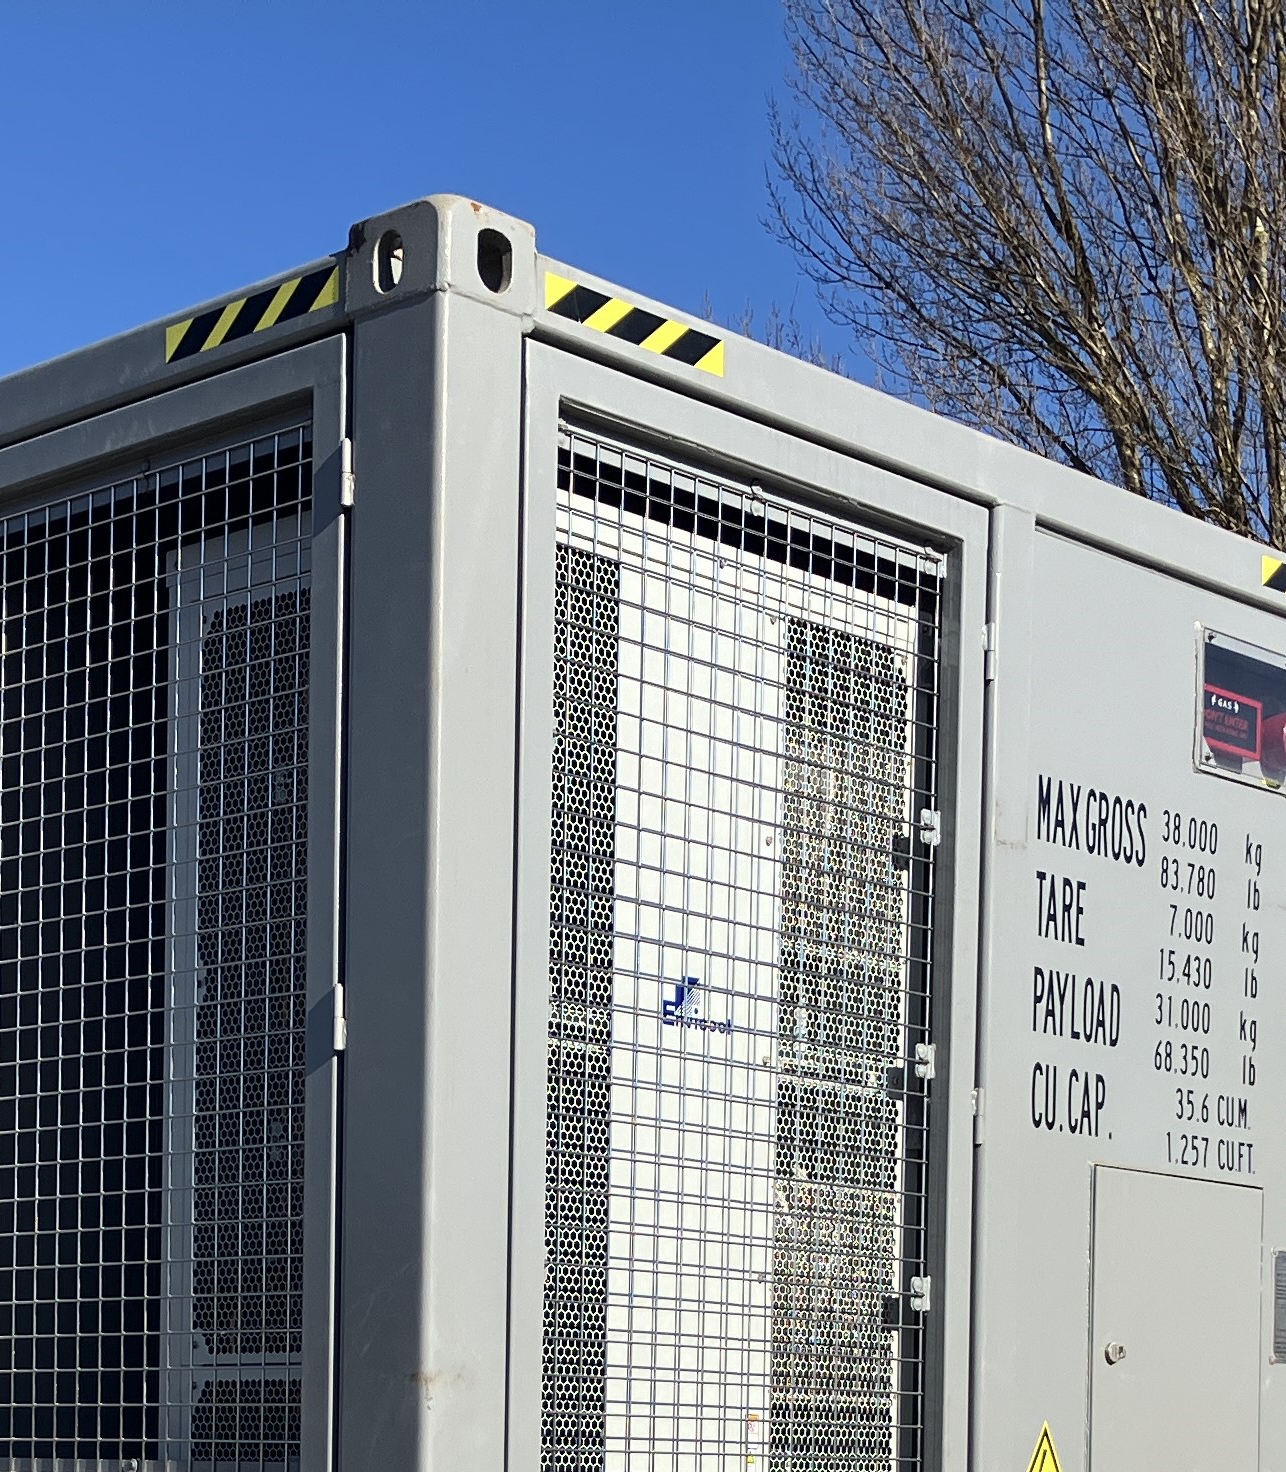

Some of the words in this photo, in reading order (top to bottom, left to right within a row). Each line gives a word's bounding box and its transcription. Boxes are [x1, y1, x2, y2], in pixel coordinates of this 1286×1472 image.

[1217, 698, 1233, 710] GAS
[1037, 773, 1081, 851] MAX
[1085, 788, 1147, 867] GROSS
[1245, 833, 1262, 877] kg
[1247, 879, 1260, 911] lb
[1036, 870, 1086, 946] TARE
[1242, 922, 1259, 964] kg
[1245, 967, 1258, 999] lb
[1032, 966, 1121, 1047] PAYLOAD
[1239, 1010, 1257, 1053] kg
[1242, 1054, 1256, 1086] lb
[1175, 1087, 1209, 1123] 35.6
